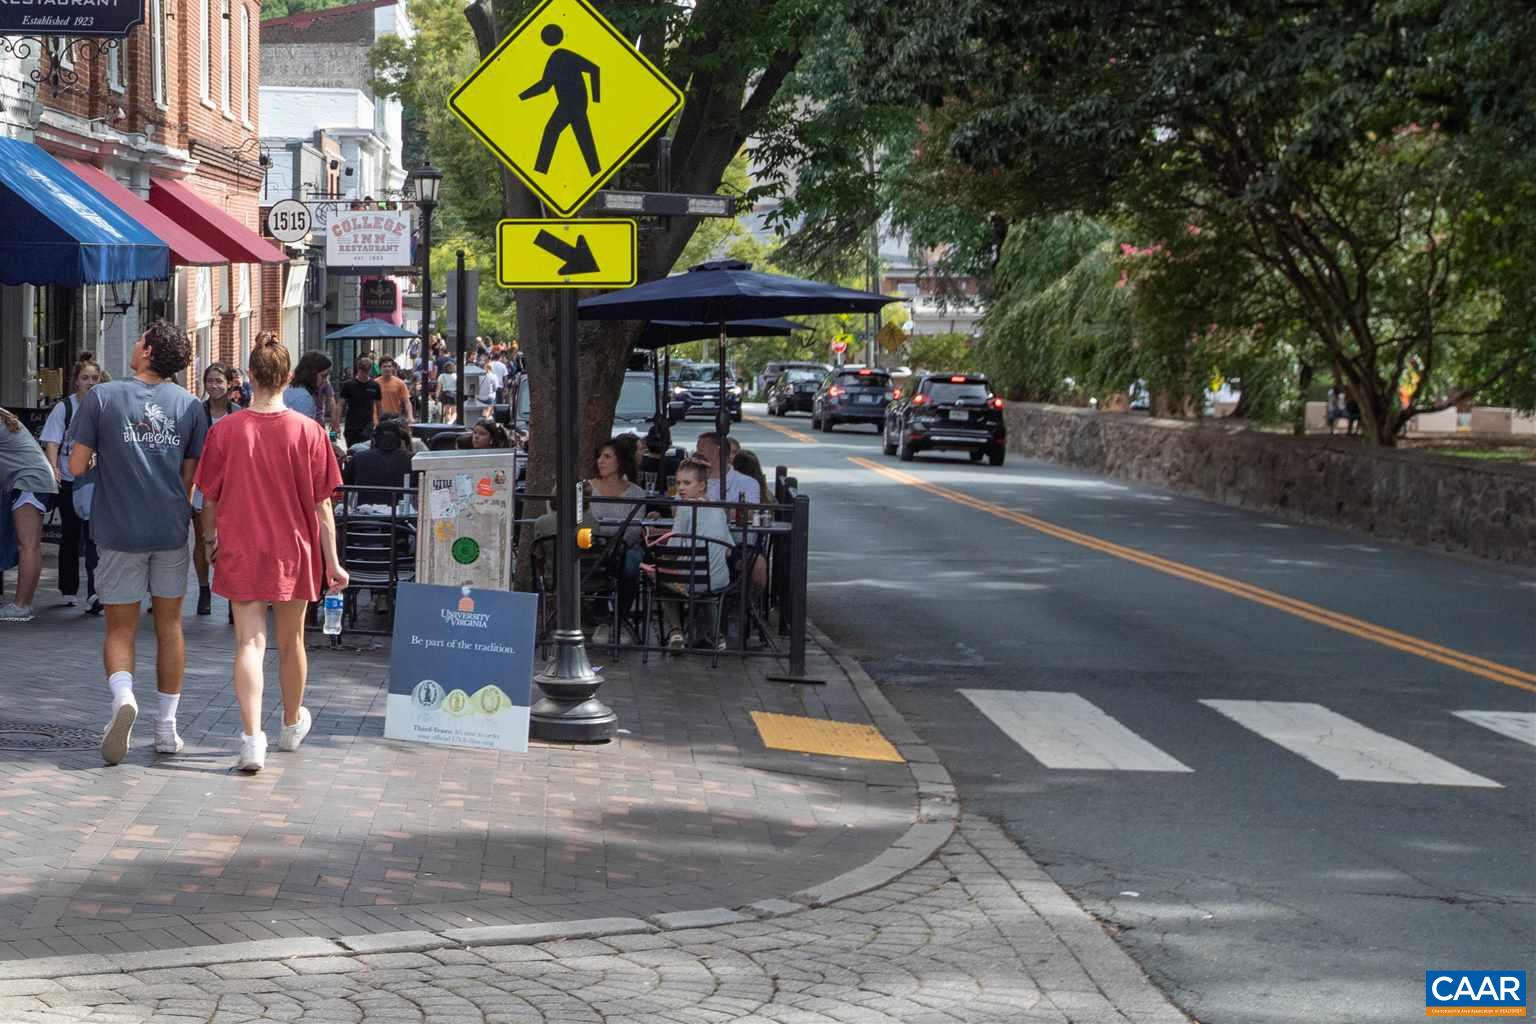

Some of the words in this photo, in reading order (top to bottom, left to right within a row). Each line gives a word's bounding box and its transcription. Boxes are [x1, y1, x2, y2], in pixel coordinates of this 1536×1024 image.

[22, 15, 71, 26] Established
[73, 16, 95, 26] 1923
[332, 216, 407, 238] COLLEGE
[352, 233, 386, 244] INN
[123, 432, 181, 446] BILLABONG
[411, 635, 423, 645] Be
[425, 639, 444, 648] part
[447, 640, 457, 648] of
[458, 640, 472, 650] the
[474, 642, 516, 654] tradition.
